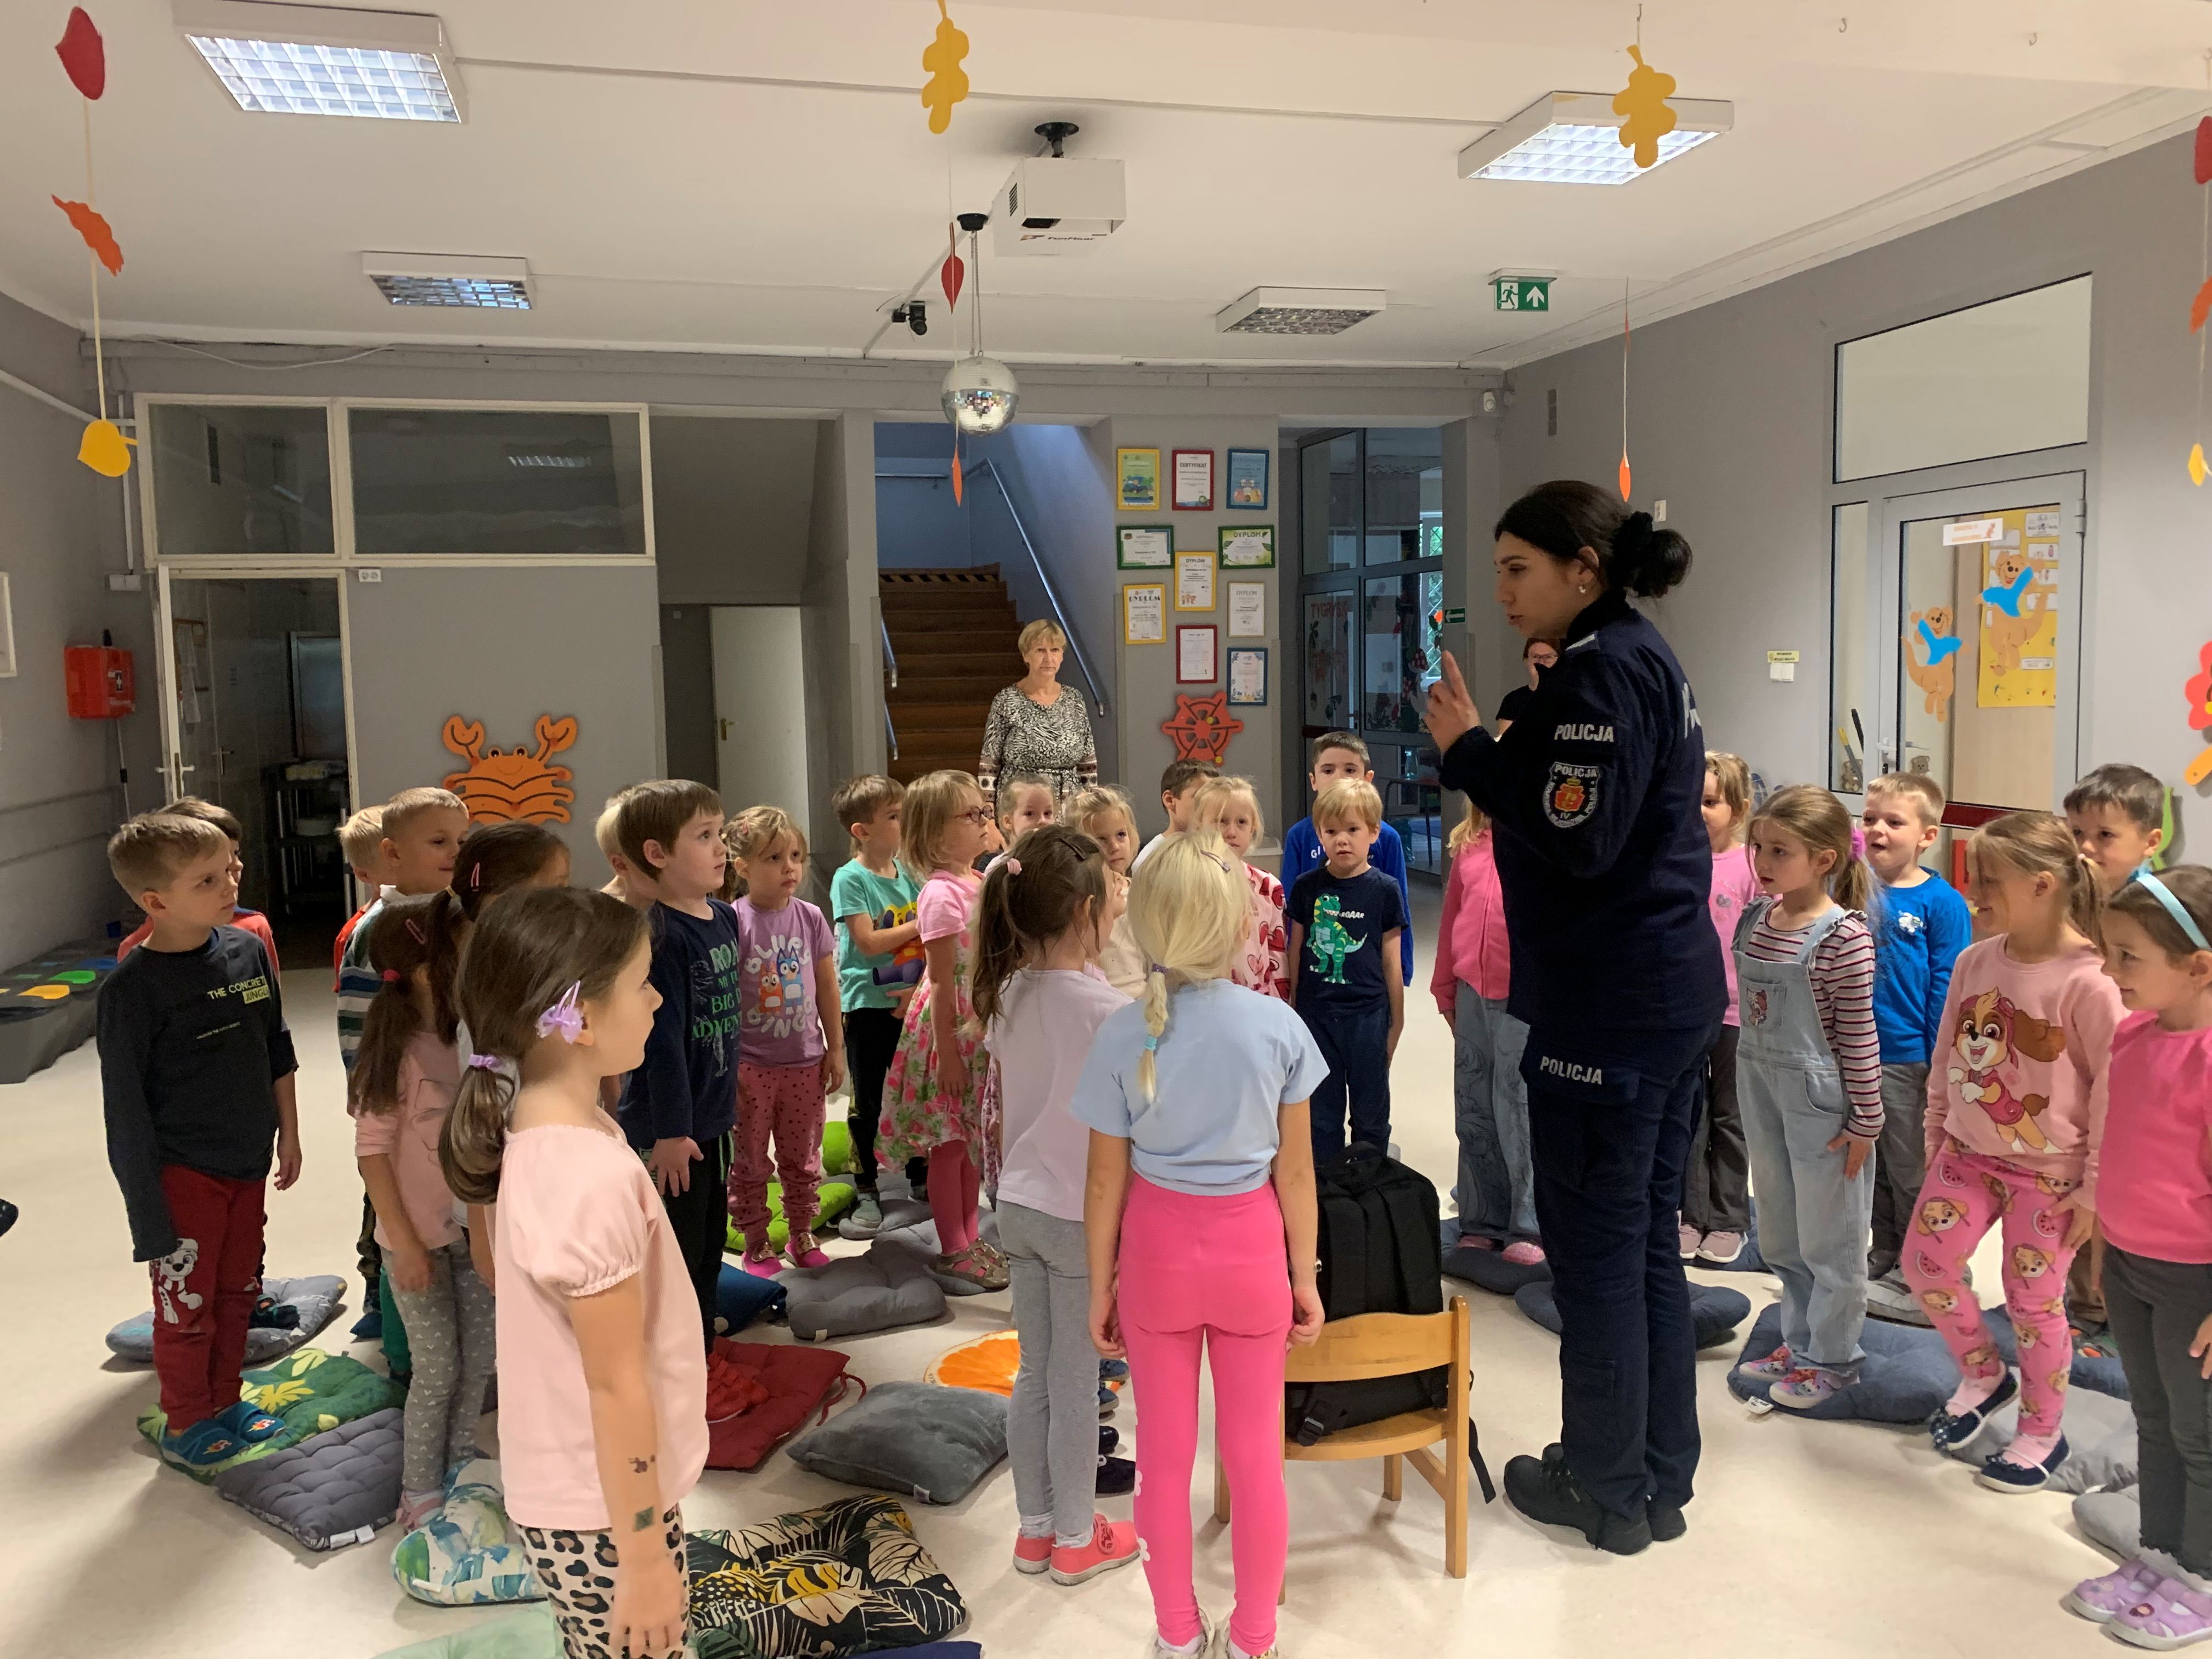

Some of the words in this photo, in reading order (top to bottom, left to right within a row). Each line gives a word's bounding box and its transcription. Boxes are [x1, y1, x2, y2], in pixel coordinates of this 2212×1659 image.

[1554, 724, 1614, 743] POLICJA
[1554, 764, 1598, 778] POLICJA
[207, 988, 227, 1000] THE
[228, 975, 267, 994] CONCRET
[245, 987, 268, 1002] JUNGL
[711, 992, 735, 1014] BIG
[1539, 1056, 1602, 1085] POLICJA
